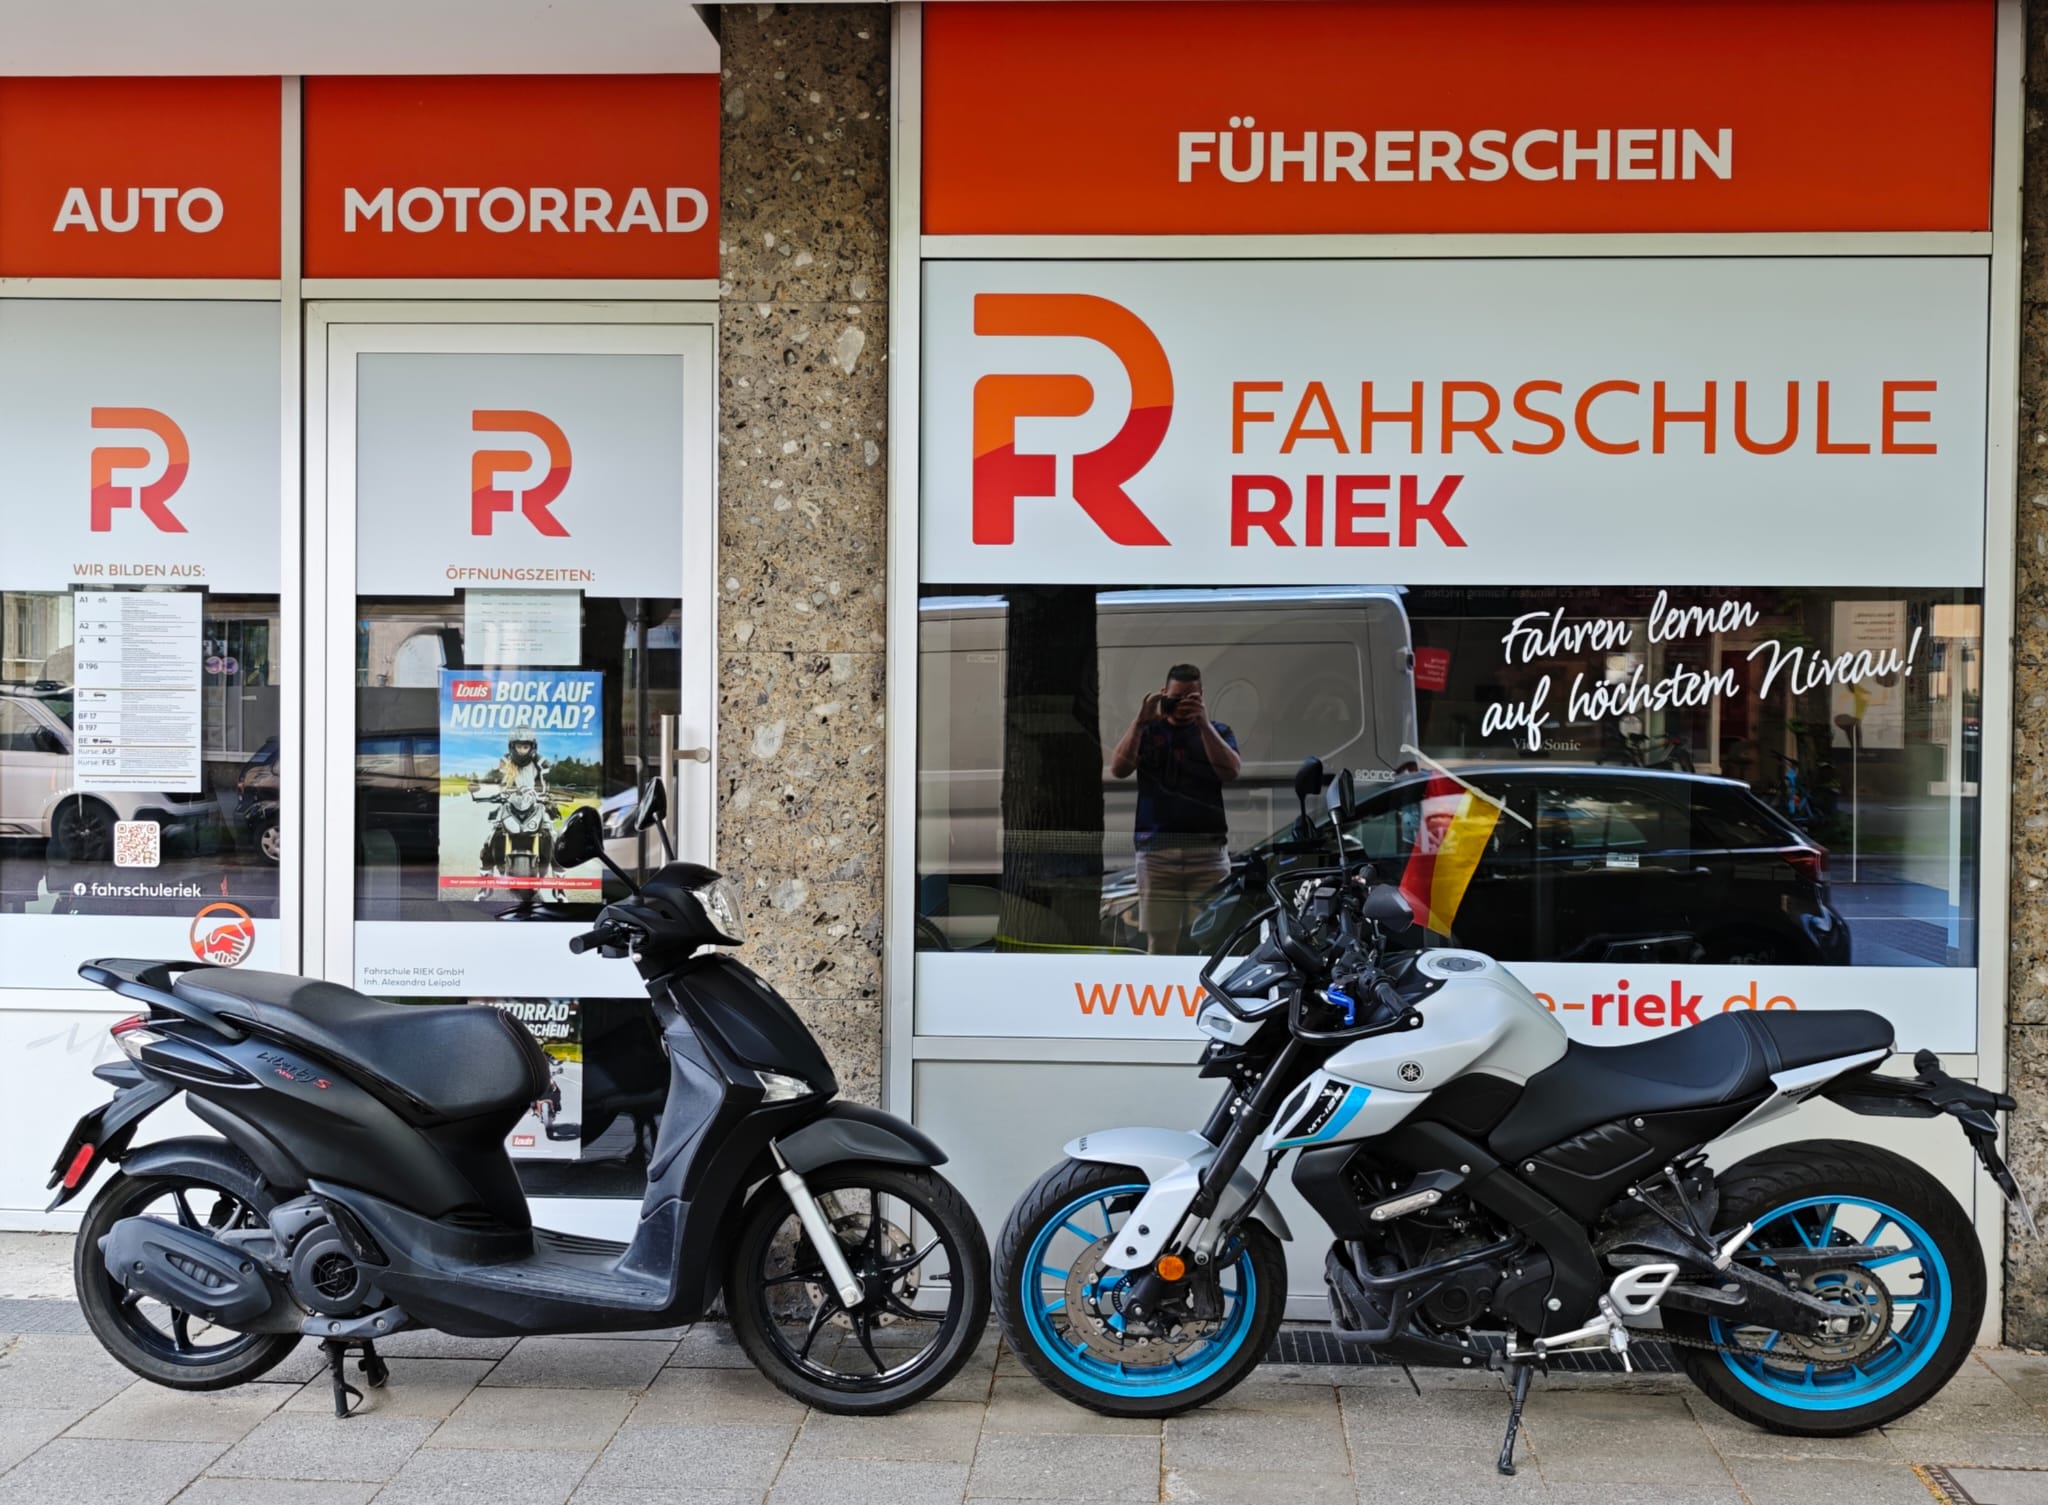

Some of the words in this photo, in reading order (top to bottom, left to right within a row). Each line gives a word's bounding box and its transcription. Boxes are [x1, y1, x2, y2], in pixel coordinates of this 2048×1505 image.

[1178, 116, 1733, 183] FÜHRERSCHEIN
[53, 187, 224, 234] AUTO
[344, 186, 709, 235] MOTORRAD
[1231, 379, 1938, 456] FAHRSCHULE
[1230, 475, 1468, 547] RIEK
[73, 563, 104, 576] WIR
[108, 564, 166, 577] BILDEN
[169, 564, 206, 577] AUS:
[445, 564, 596, 582] ÖFFNUNGSZEITEN:
[1501, 606, 1633, 665] Fahren
[1647, 589, 1760, 644] lernen
[455, 683, 489, 698] Louis
[495, 681, 552, 703] BOCK
[552, 681, 595, 703] AUF
[1481, 674, 1551, 753] auf
[1568, 663, 1740, 723] höchstem
[1746, 626, 1923, 700] Niveau!
[450, 703, 597, 730] MOTORRAD?
[1511, 737, 1582, 752] ViSonic
[91, 882, 202, 898] fahrschuleriek
[364, 967, 411, 976] Fahrschule
[413, 967, 434, 976] RIEK
[436, 968, 465, 976] GmbH
[381, 978, 426, 987] Alexandra
[428, 978, 461, 988] Leipold
